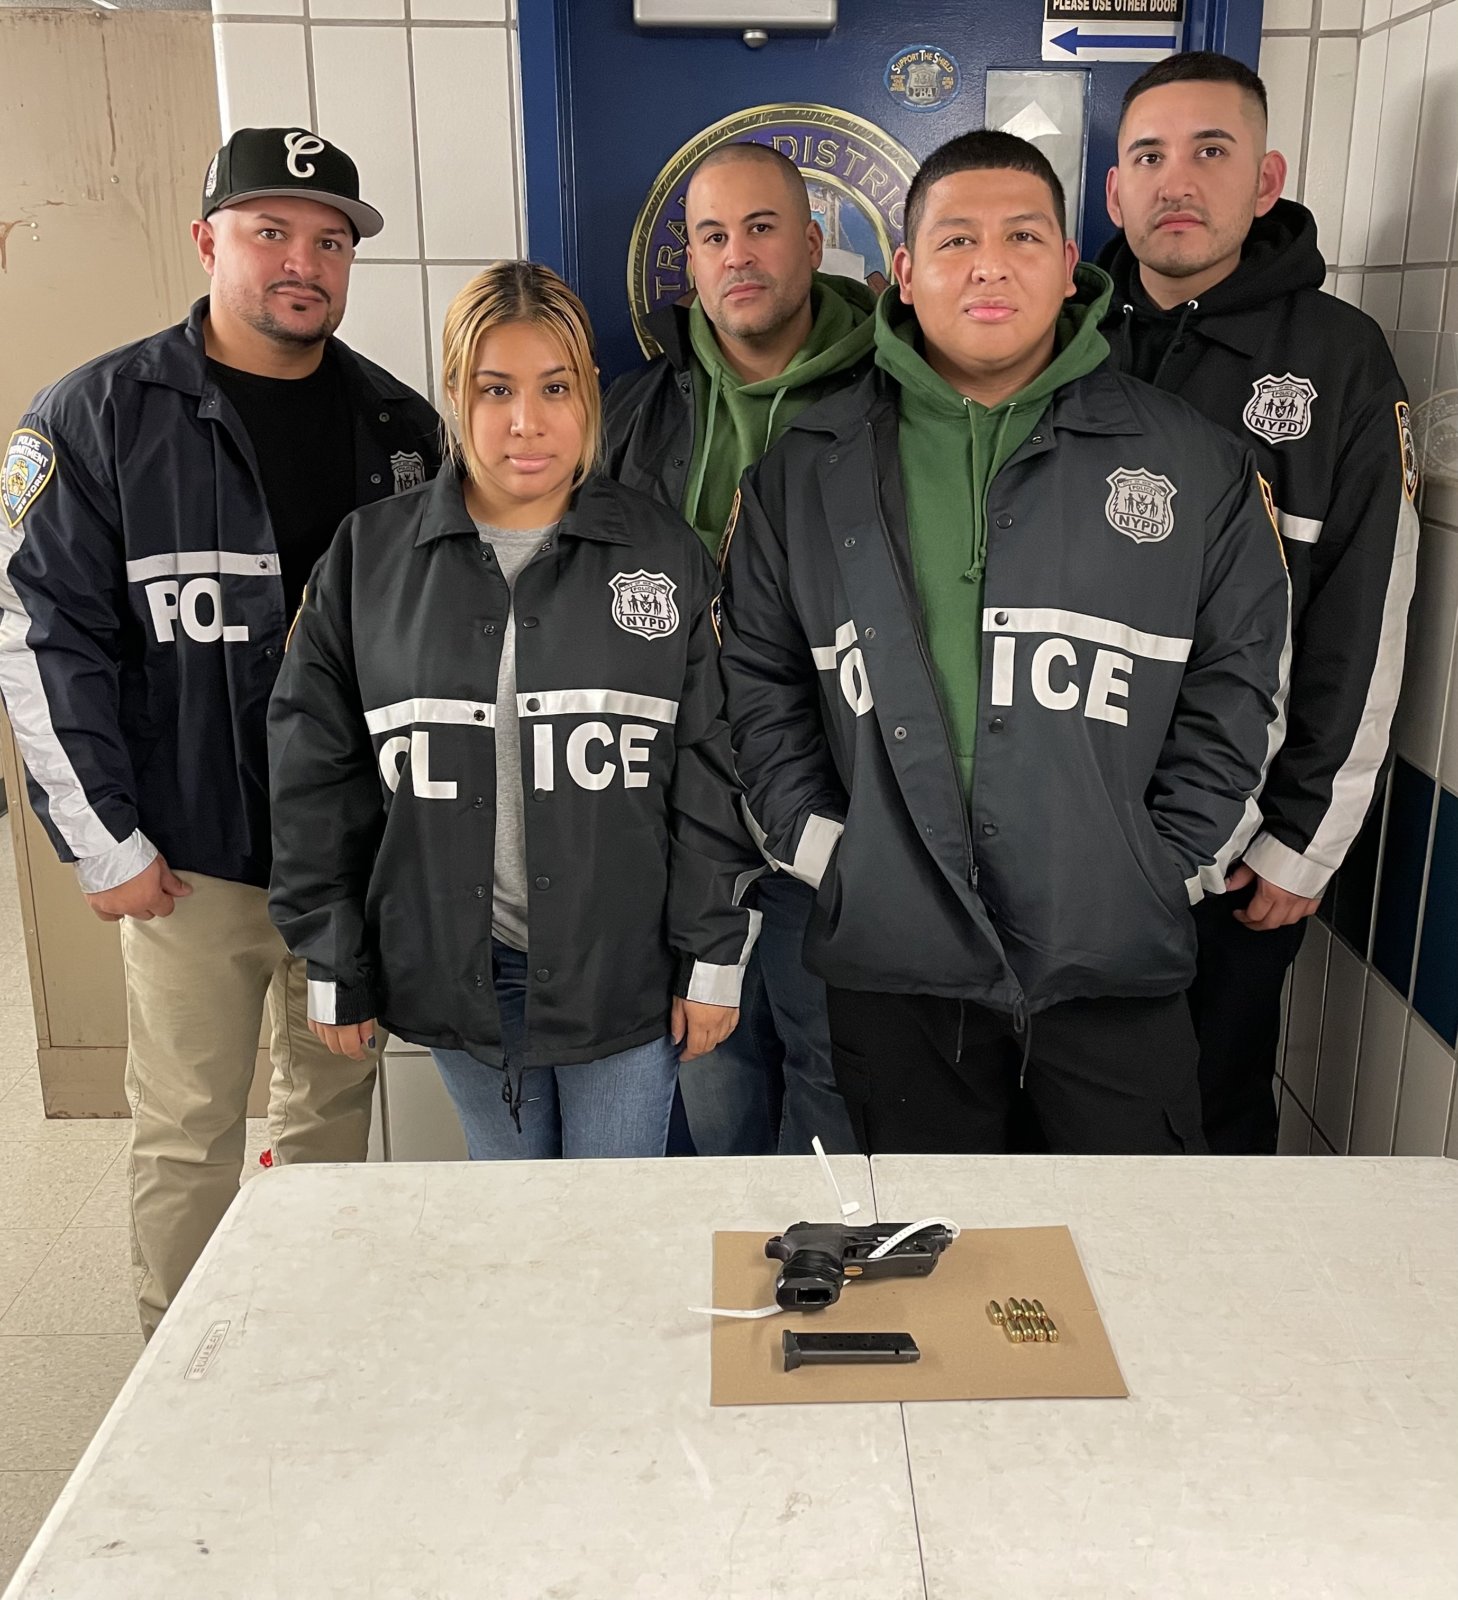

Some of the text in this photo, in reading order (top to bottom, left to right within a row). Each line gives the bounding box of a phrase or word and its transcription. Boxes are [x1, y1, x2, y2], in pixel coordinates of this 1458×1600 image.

[1052, 0, 1177, 12] PLEASE USE OTHER DOOR
[913, 87, 934, 97] PBA
[655, 196, 688, 301] TRA
[1253, 417, 1298, 433] NYPD
[16, 435, 41, 451] POLICE
[25, 473, 46, 498] YORK
[1119, 514, 1160, 535] NYPD
[626, 616, 666, 630] NYPD
[991, 636, 1134, 727] ICE
[533, 721, 659, 792] ICE
